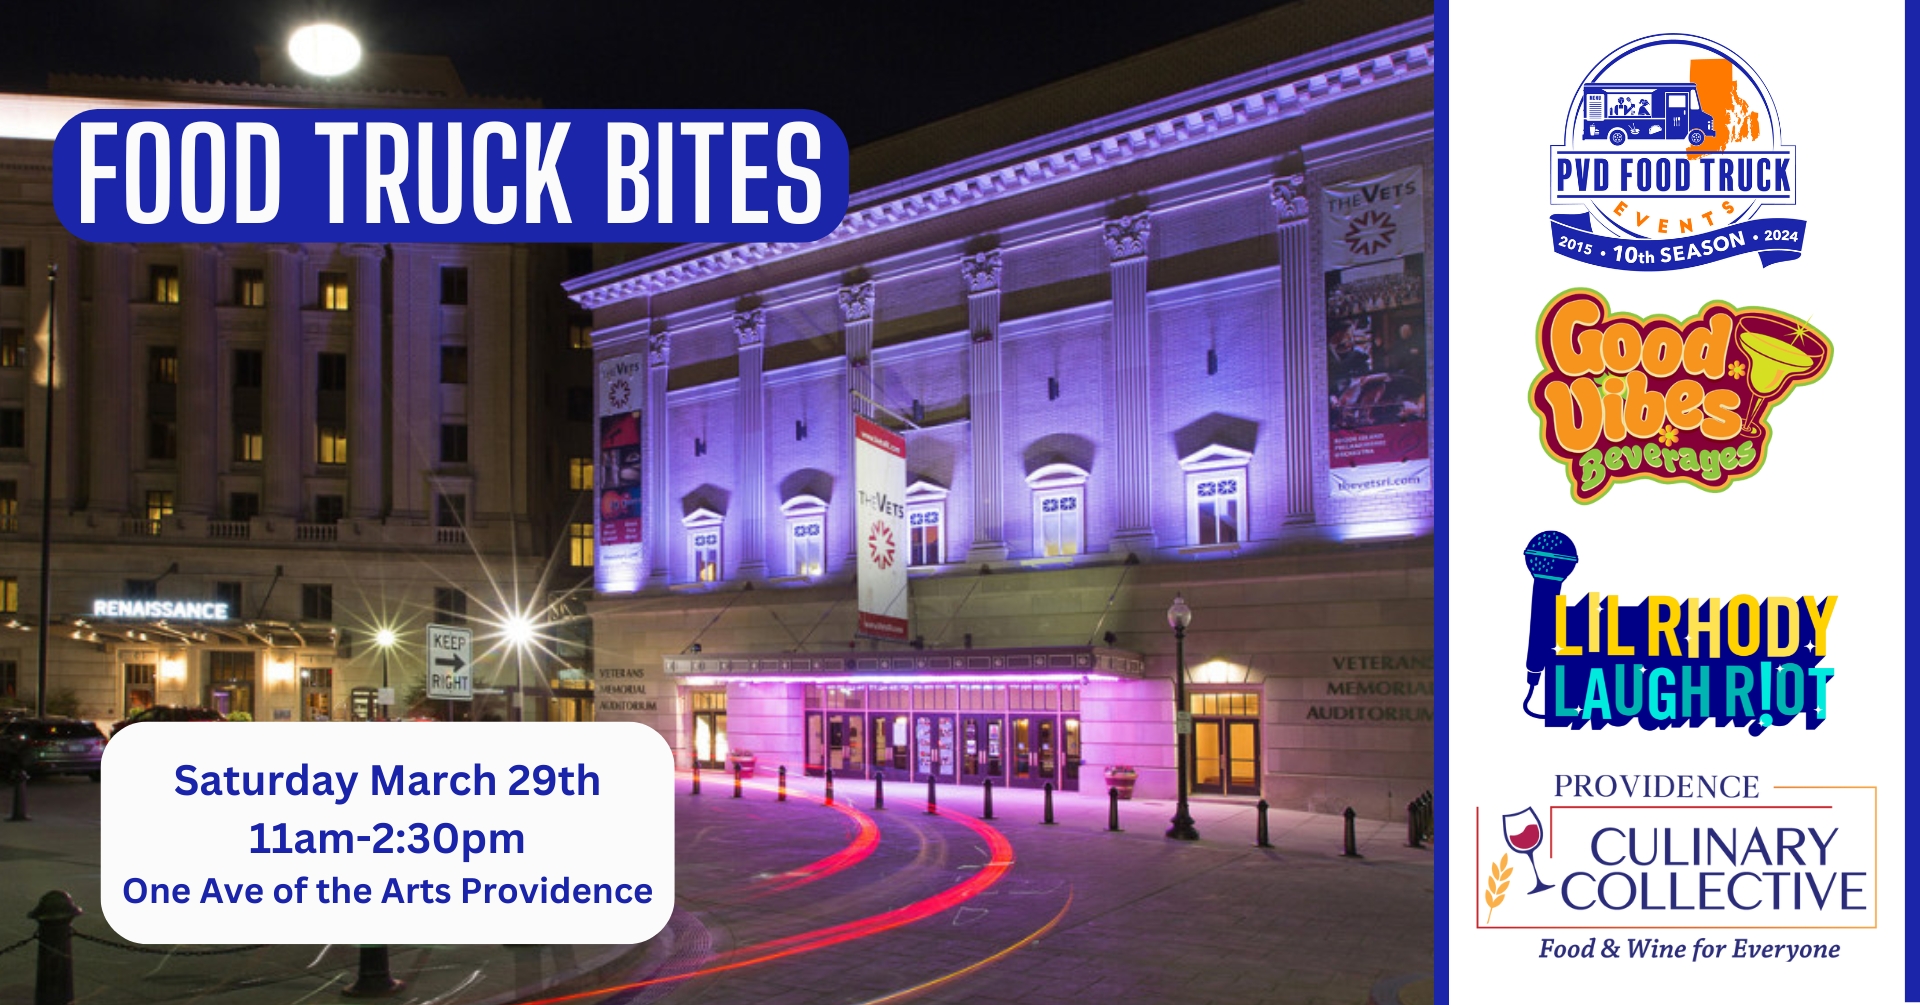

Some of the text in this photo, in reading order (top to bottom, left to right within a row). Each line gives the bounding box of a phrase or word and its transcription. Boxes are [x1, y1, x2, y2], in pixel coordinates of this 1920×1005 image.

[94, 599, 229, 619] RENAISSANCE
[434, 633, 466, 650] KEEP
[599, 669, 644, 678] VETERANS
[432, 674, 468, 690] RIGHT
[600, 685, 646, 695] MEMORIAL
[600, 701, 657, 711] AUDITORIUM
